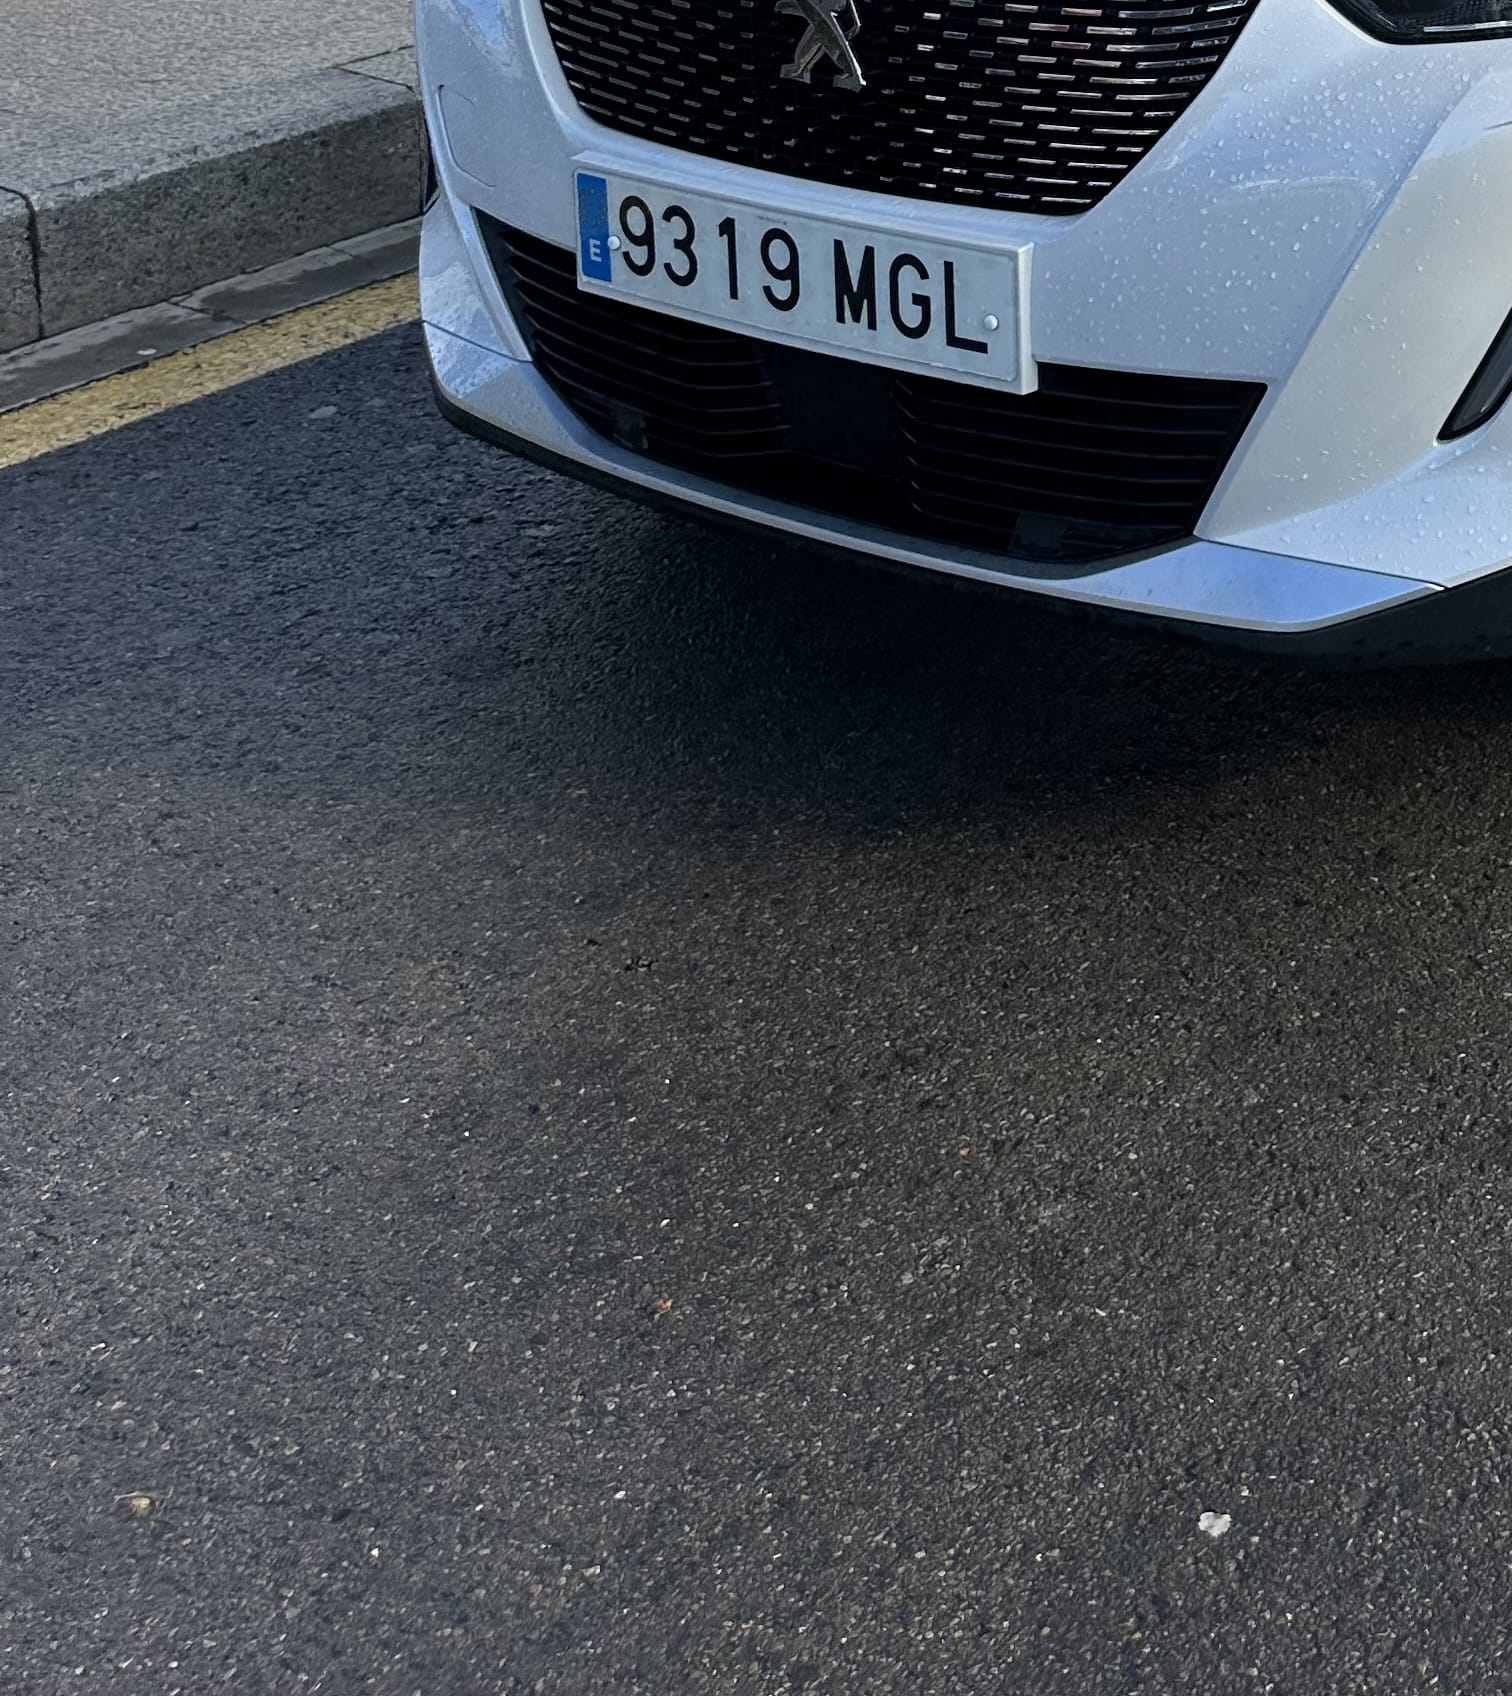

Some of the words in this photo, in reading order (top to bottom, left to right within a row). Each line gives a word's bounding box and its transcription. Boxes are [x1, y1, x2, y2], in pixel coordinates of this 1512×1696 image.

[588, 237, 603, 263] E
[619, 195, 801, 312] 9319
[833, 239, 989, 355] MGL
